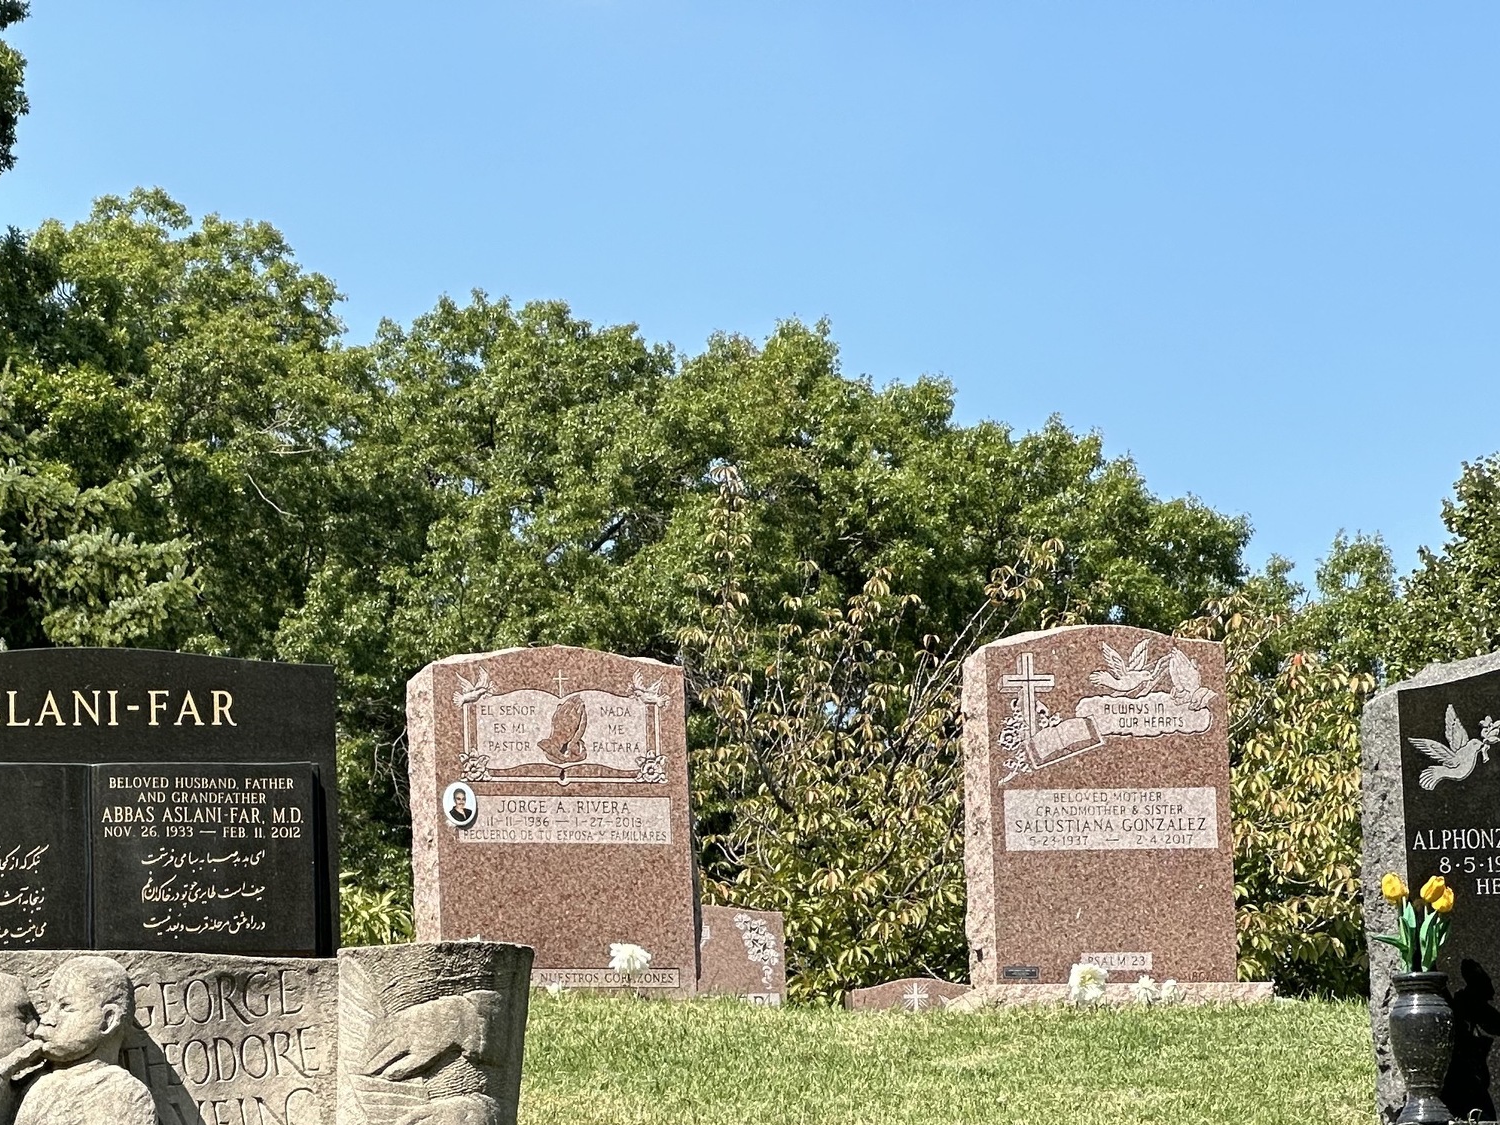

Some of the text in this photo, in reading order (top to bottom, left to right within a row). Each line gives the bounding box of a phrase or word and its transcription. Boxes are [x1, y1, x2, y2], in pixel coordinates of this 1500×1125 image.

[480, 705, 493, 716] EL
[600, 706, 632, 717] NADA
[1104, 703, 1150, 715] ALWAYS
[493, 723, 526, 734] ES MI
[608, 724, 626, 735] ME
[1119, 717, 1184, 728] OUR HEARTS
[488, 741, 531, 752] PASTOR
[109, 777, 169, 789] BELOVED
[245, 778, 294, 789] FATHER
[138, 792, 267, 804] AND GRANDFATHER
[497, 799, 547, 814] JORGE
[577, 800, 632, 815] RIVERA
[1036, 804, 1183, 816] GRANDMOTHER & SISTER
[101, 806, 155, 824] ABBAS
[273, 807, 304, 824] M.D.
[104, 826, 136, 838] NOV.
[166, 826, 194, 838] 1933
[223, 826, 249, 838] FEB.
[271, 826, 302, 838] 2012
[1015, 817, 1207, 833] SALUSTIANA GONZALEZ
[463, 829, 517, 841] RECUERDO
[520, 829, 534, 840] DE
[539, 830, 552, 840] TU
[557, 830, 593, 841] ESPOSA
[610, 830, 667, 842] FAMILIARES
[8, 856, 19, 871] از
[19, 845, 40, 870] که
[207, 850, 239, 872] صبا
[250, 849, 265, 866] ای
[217, 881, 246, 898] است
[241, 884, 266, 901] حیف
[142, 907, 172, 935] نیست
[185, 916, 209, 934] قرب
[228, 911, 248, 934] عشق
[245, 915, 257, 930] راه
[255, 921, 266, 931] در
[1131, 955, 1147, 966] 23
[540, 972, 599, 984] NUESTROS
[604, 972, 675, 984] CORZONES
[132, 968, 304, 1031] GEORGE
[117, 1024, 321, 1087] THEODORE
